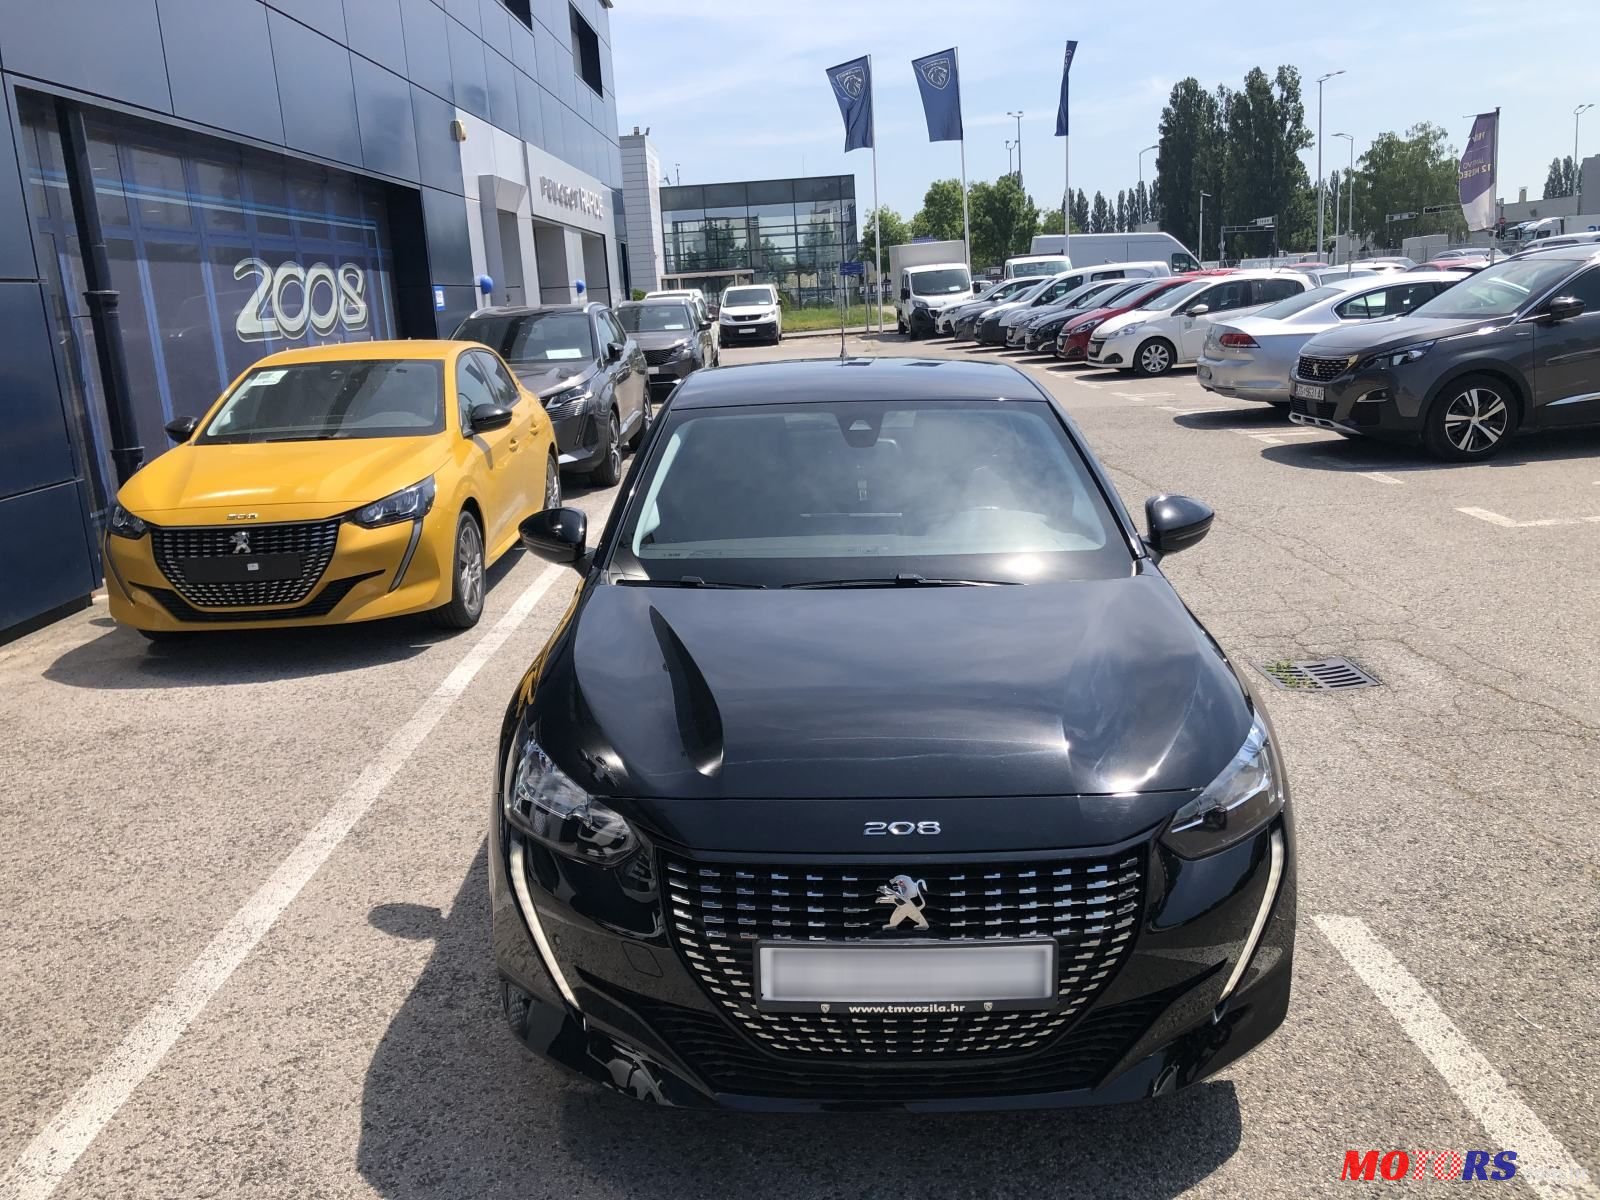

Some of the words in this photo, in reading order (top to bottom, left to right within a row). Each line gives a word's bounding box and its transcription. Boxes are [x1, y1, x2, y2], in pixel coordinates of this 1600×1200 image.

[234, 257, 368, 342] 2008
[863, 821, 941, 835] 208
[849, 1003, 966, 1013] www.tmvozila.hr
